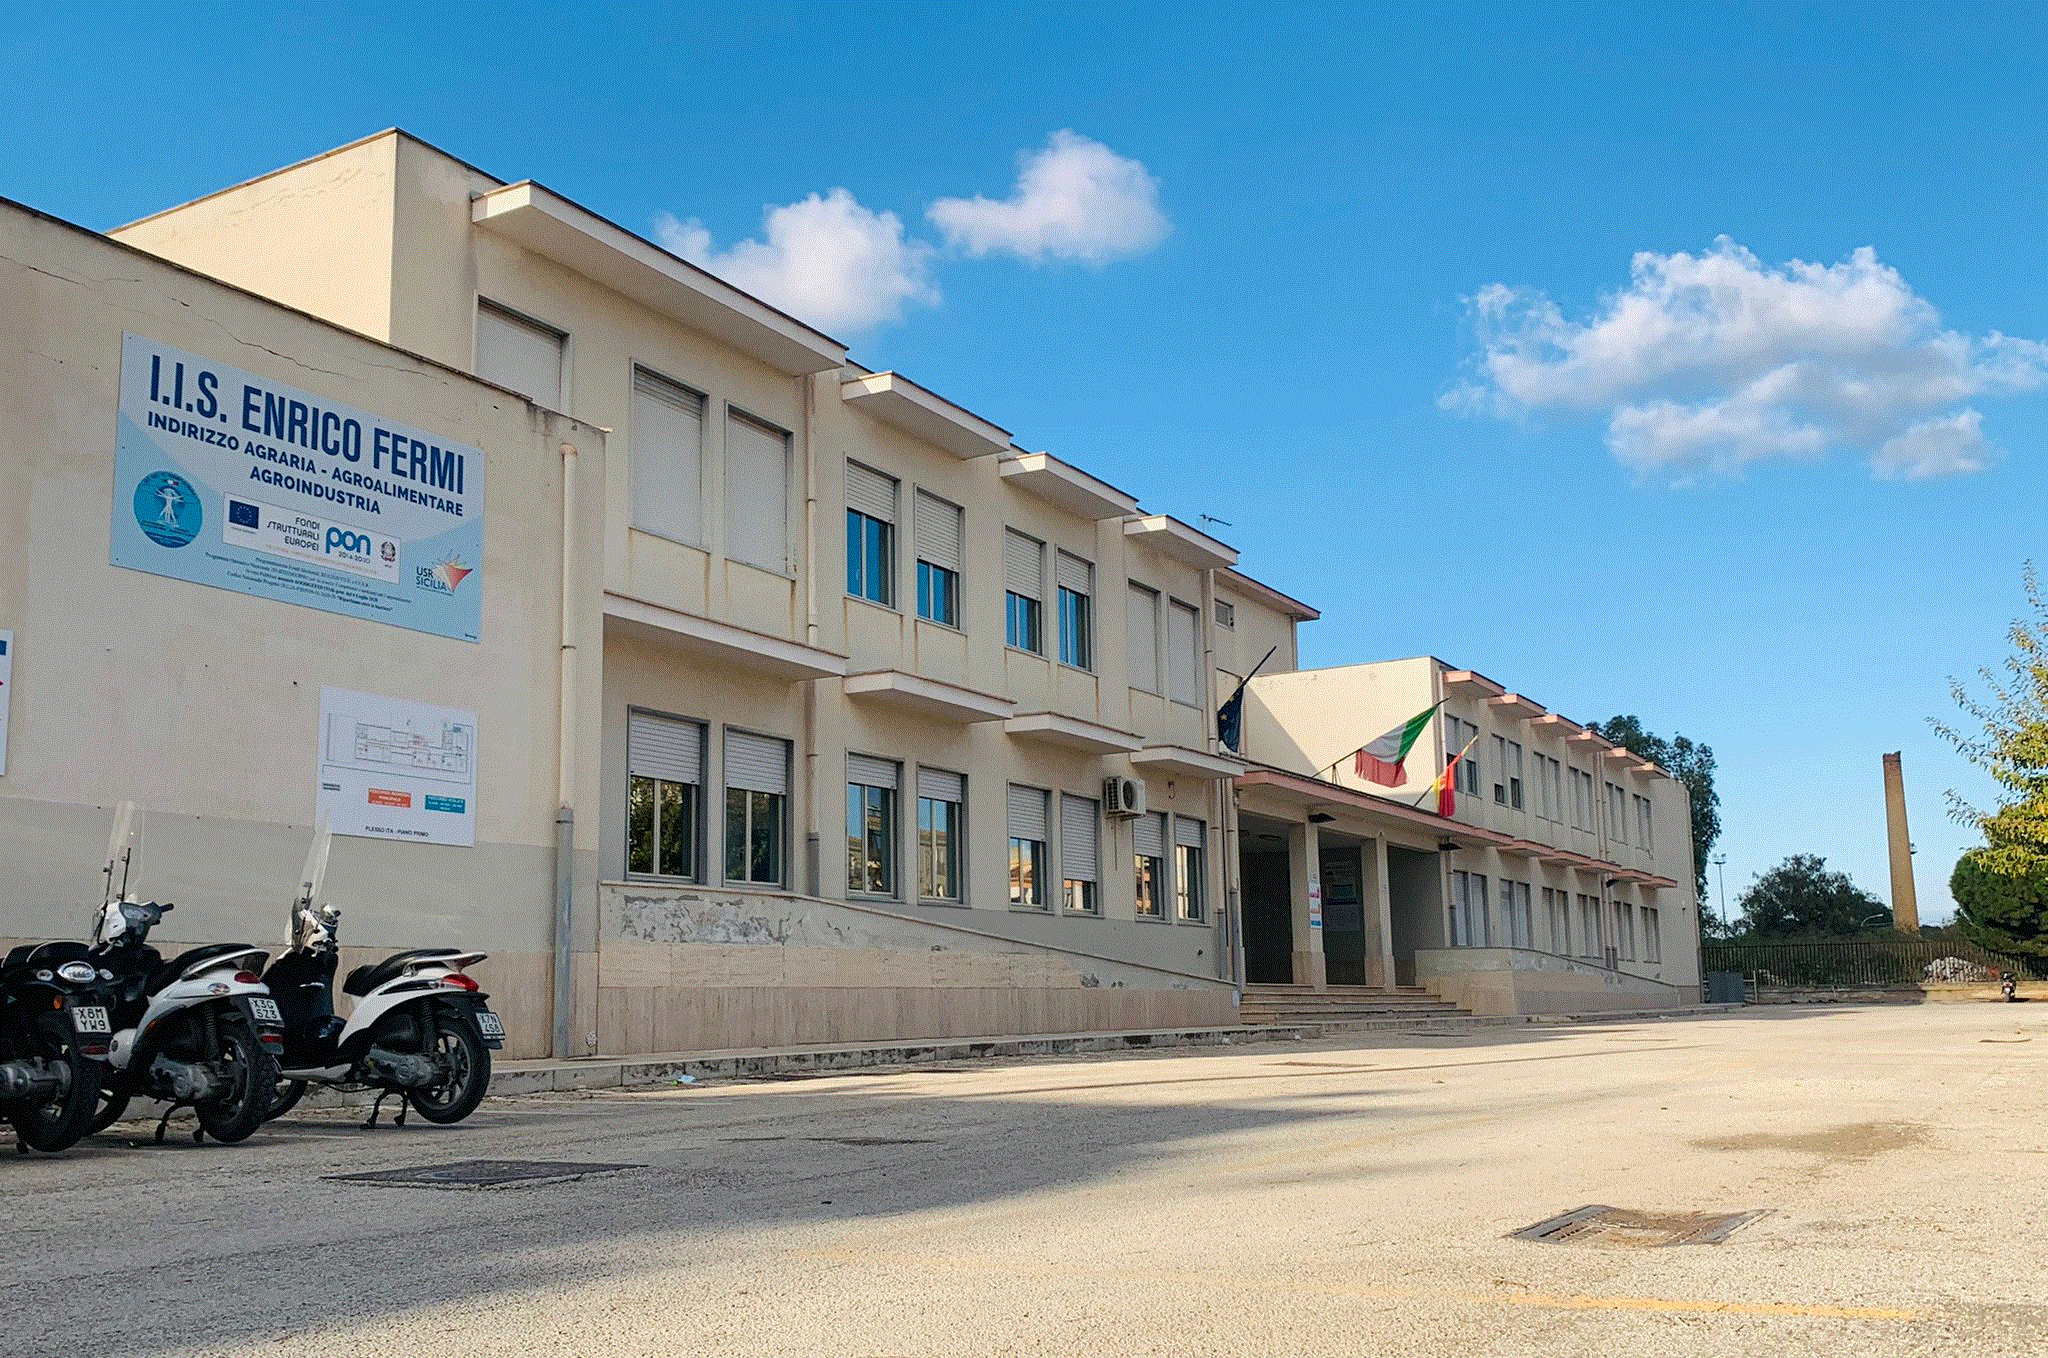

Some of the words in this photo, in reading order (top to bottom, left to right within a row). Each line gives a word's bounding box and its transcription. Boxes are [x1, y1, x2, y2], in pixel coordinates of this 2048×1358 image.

[150, 354, 227, 424] I.I.S.
[241, 384, 361, 463] ENRICO
[373, 427, 464, 495] FERMI
[147, 411, 239, 451] INDIRIZZO
[244, 441, 317, 475] AGRARIA
[331, 467, 463, 517] AGROALIMENTARE
[249, 466, 381, 515] AGROINDUSTRIA
[266, 520, 320, 541] STRUTTURALI
[294, 517, 320, 531] FONDI
[284, 535, 319, 552] EUROPEI
[325, 526, 371, 556] pon
[416, 565, 434, 579] USR
[415, 576, 447, 592] SICILIA
[78, 1008, 104, 1019] X8M
[80, 1019, 106, 1030] YW9
